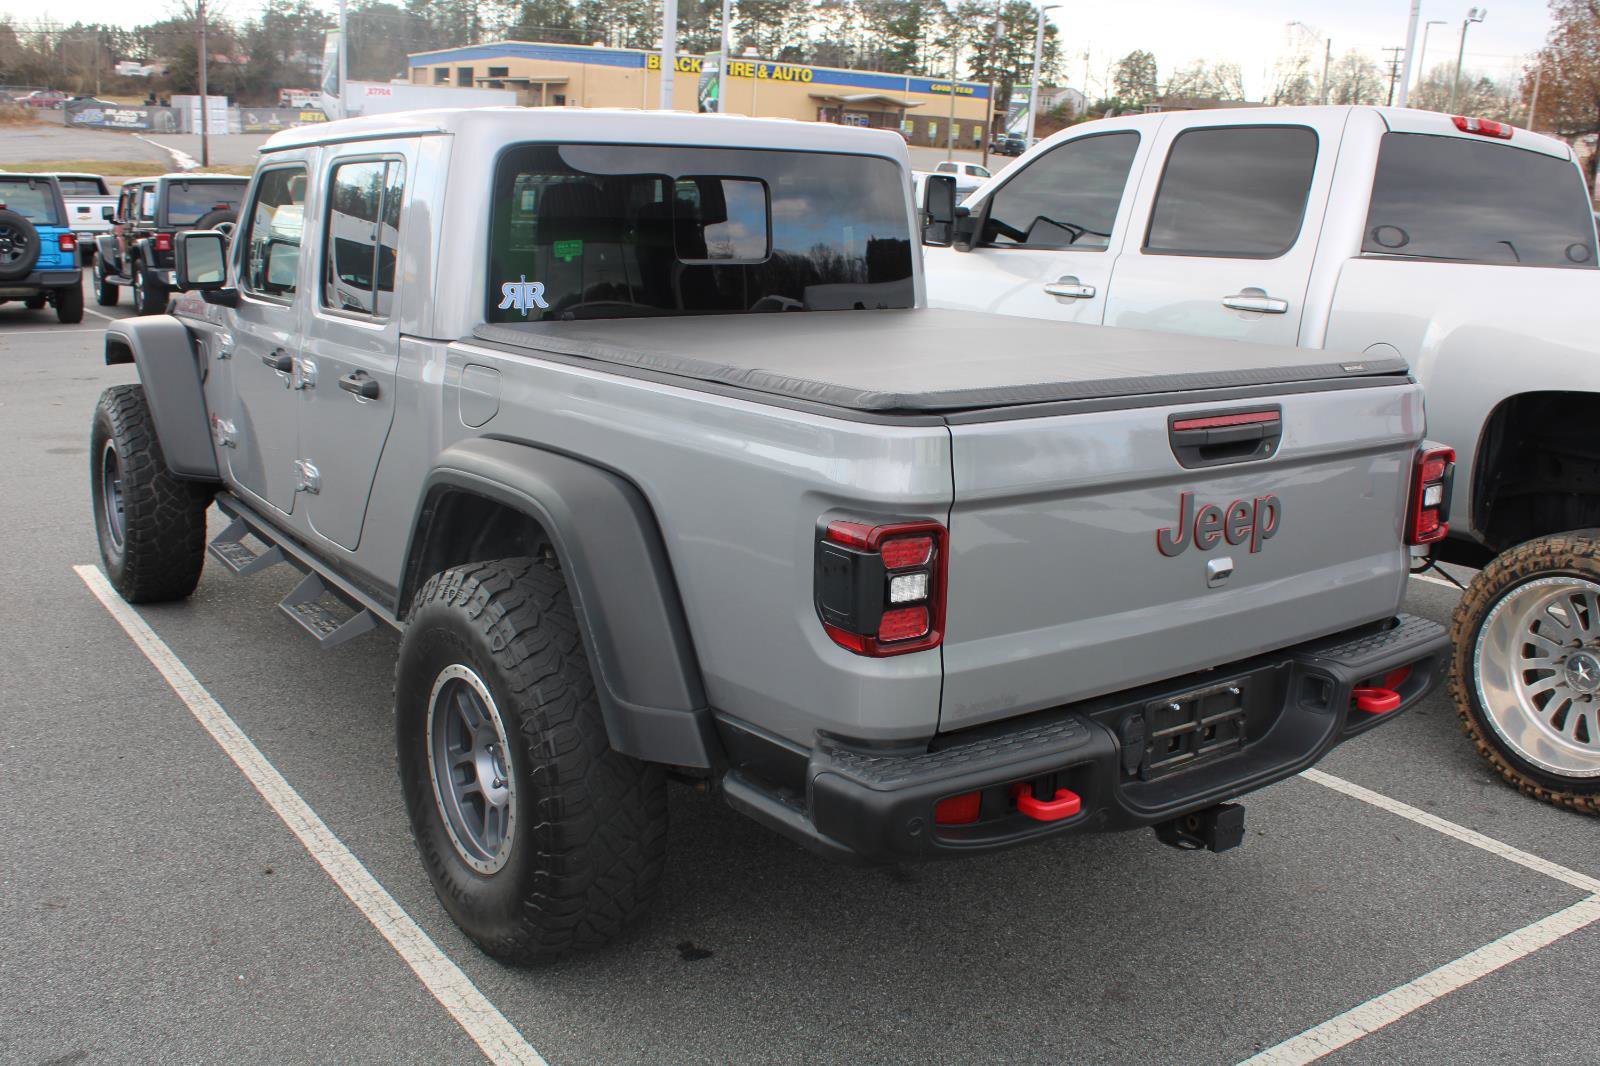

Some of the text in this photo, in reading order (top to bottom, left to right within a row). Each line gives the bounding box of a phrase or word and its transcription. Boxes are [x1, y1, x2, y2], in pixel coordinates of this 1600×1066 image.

[727, 61, 755, 78] IRE
[757, 64, 769, 79] &
[772, 65, 813, 83] AUTO
[1156, 491, 1282, 557] Jeep
